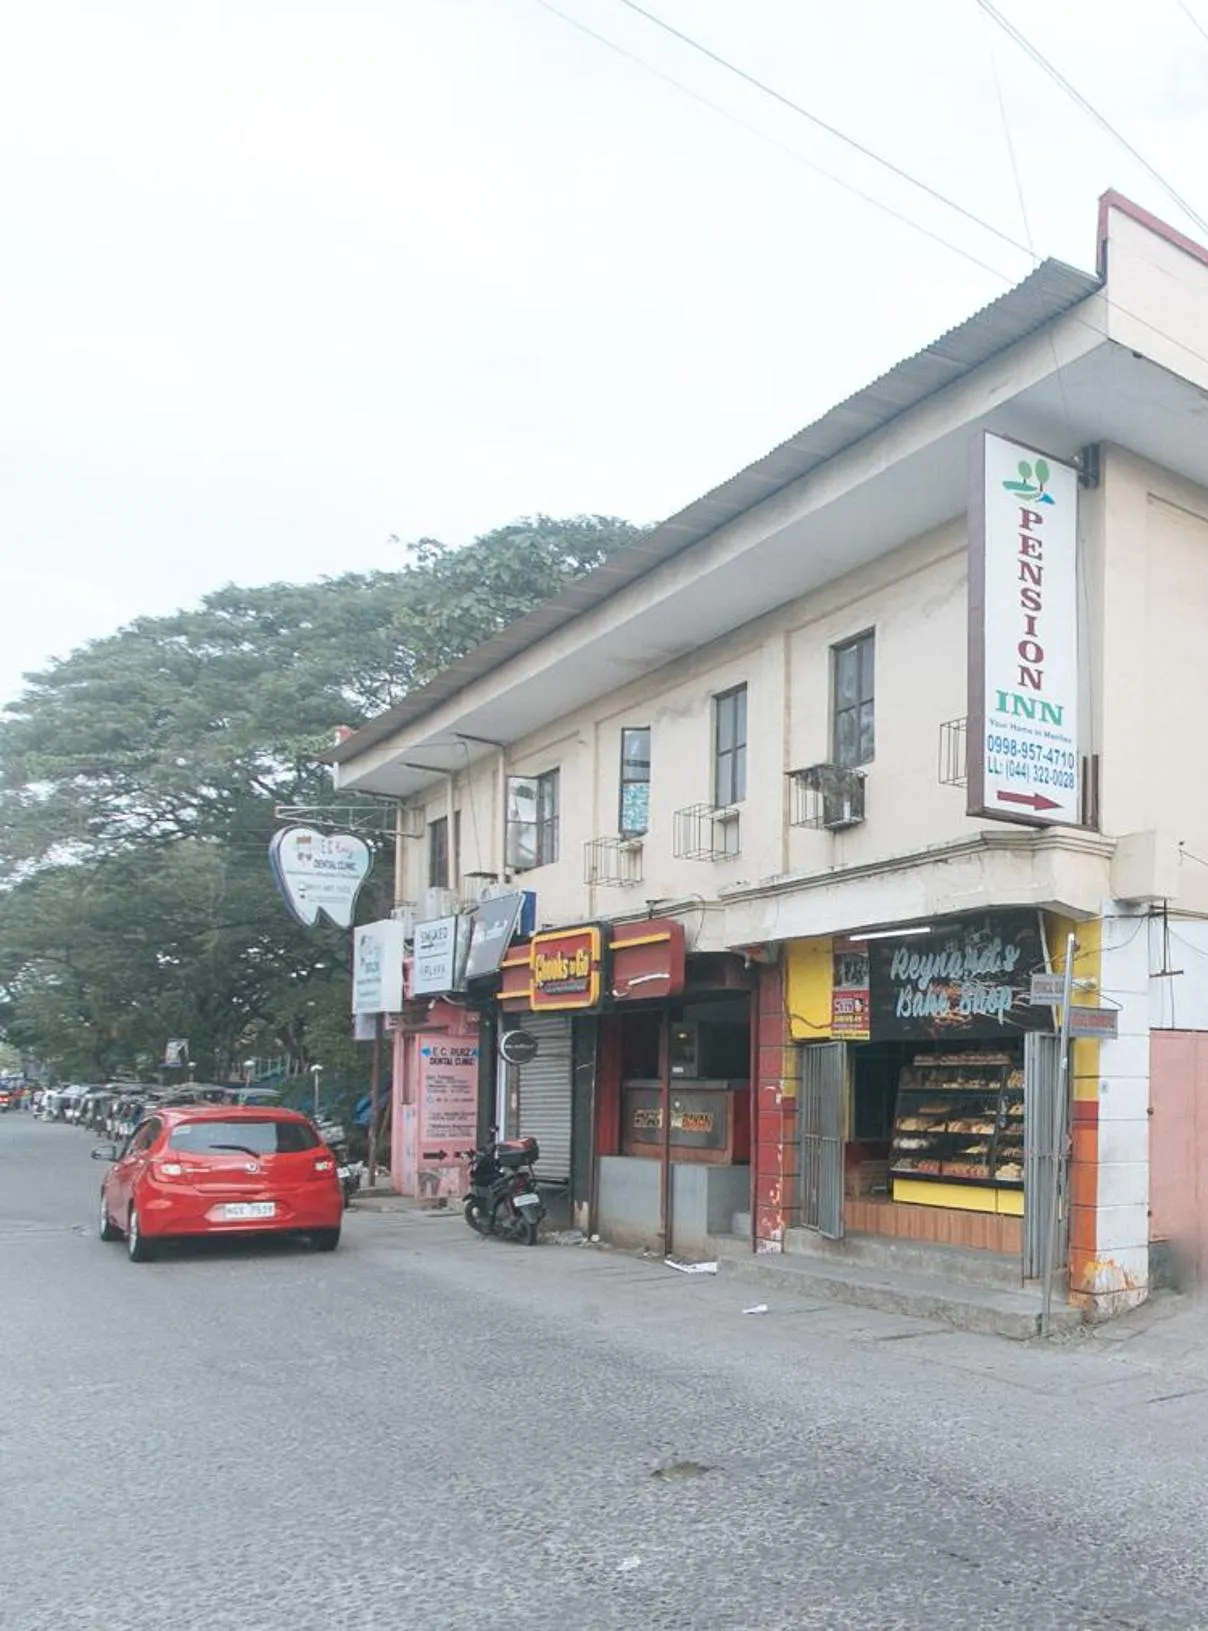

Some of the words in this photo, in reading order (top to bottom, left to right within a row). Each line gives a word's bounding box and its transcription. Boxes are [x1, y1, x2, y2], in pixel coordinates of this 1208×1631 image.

[1018, 506, 1044, 691] PENSION
[996, 689, 1064, 726] INN
[987, 734, 1075, 770] 0998-957-4710
[1006, 758, 1030, 784] (044)
